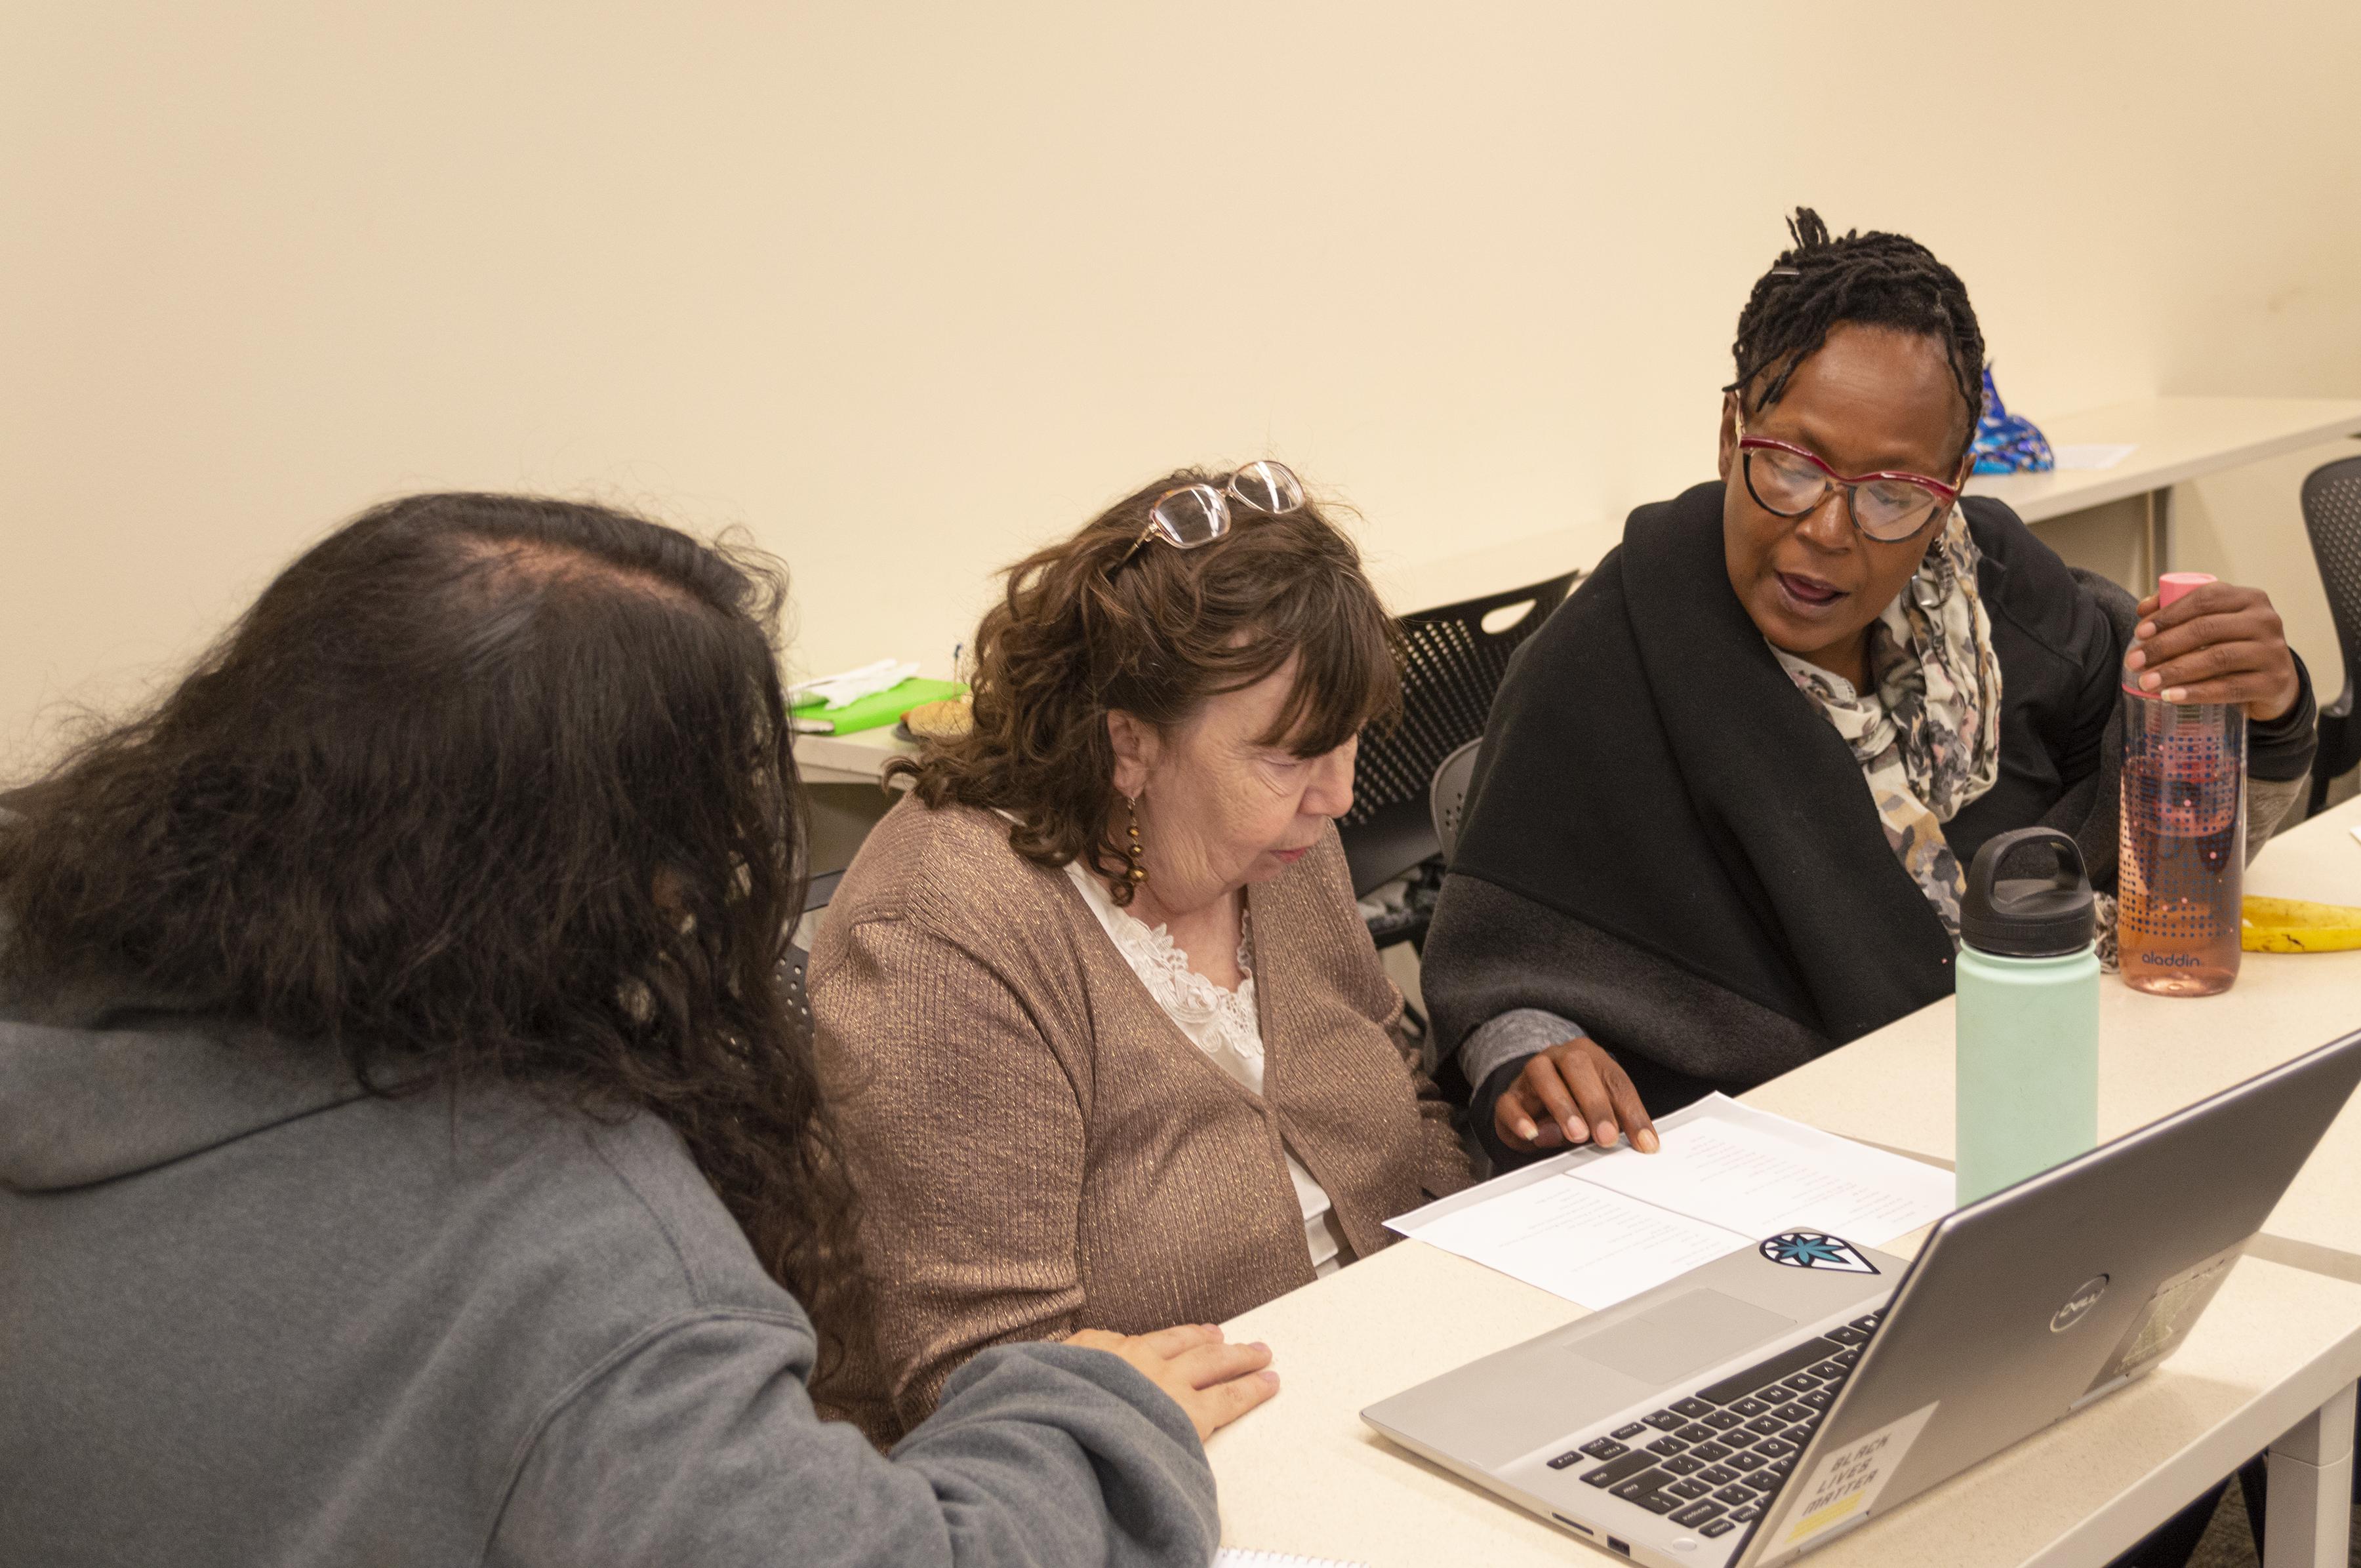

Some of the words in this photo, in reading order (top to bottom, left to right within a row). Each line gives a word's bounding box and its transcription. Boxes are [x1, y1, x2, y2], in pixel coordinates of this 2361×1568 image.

[2142, 952, 2201, 967] aladdin
[1743, 1401, 1756, 1410] M
[1831, 1433, 1892, 1472] BLACK
[1802, 1468, 1879, 1517] MATTER
[1815, 1457, 1872, 1495] LIVES
